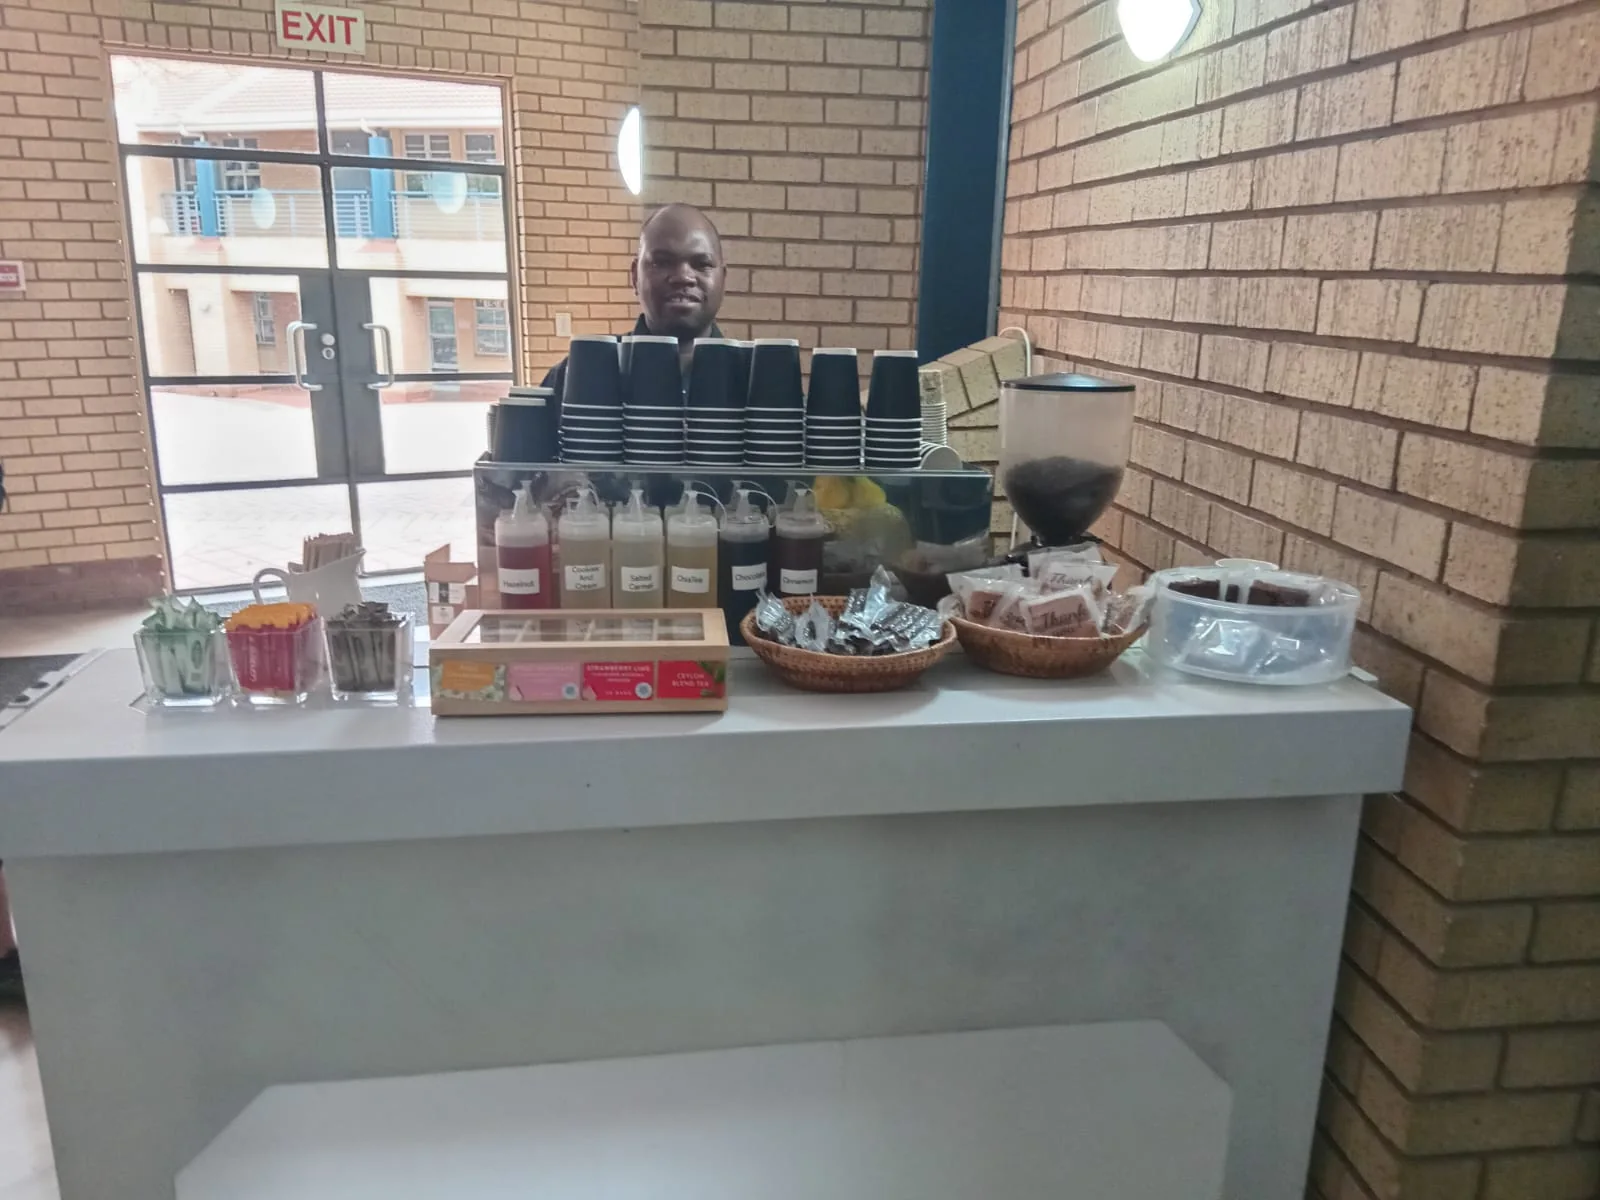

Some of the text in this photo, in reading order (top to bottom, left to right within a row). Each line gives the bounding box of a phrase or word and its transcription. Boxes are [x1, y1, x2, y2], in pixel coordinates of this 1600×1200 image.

[281, 9, 358, 45] EXIT
[586, 664, 632, 672] STRAWBERRY
[676, 672, 705, 680] CEYLON
[696, 680, 709, 688] TEA
